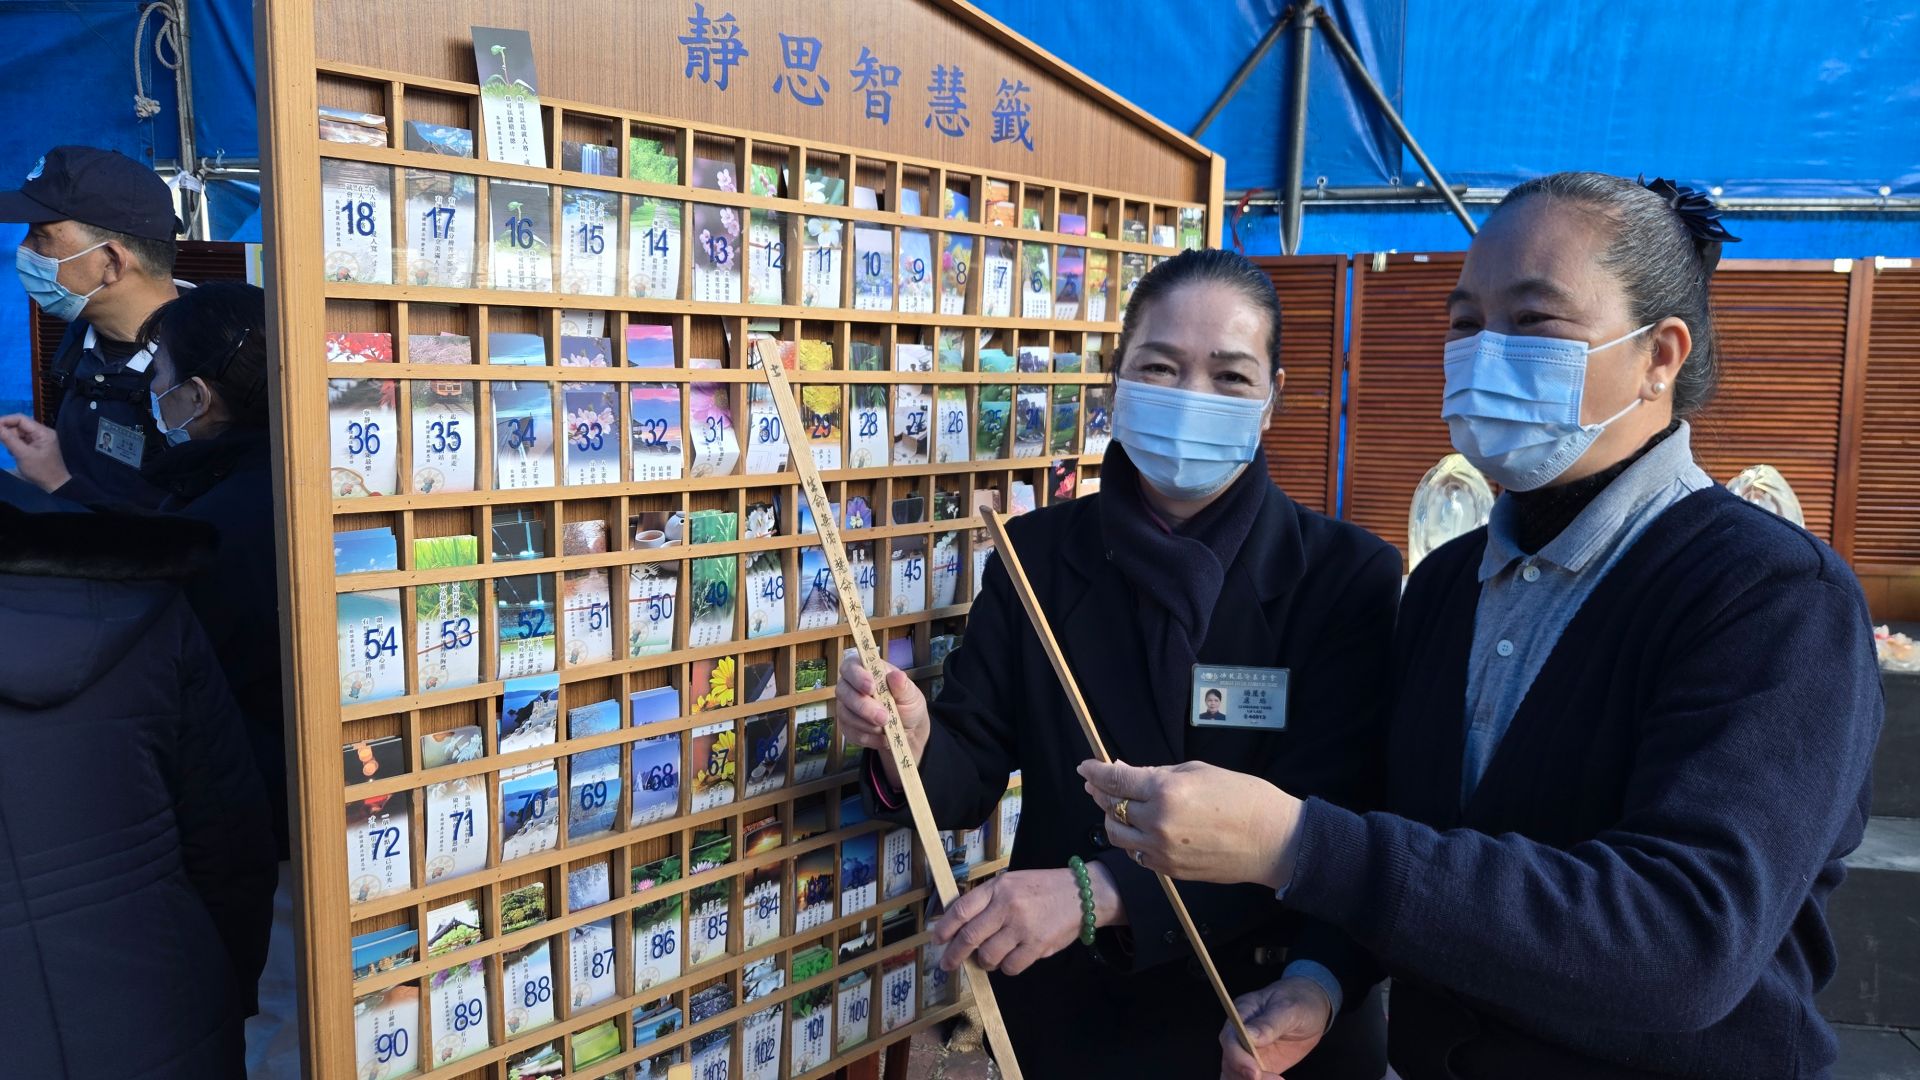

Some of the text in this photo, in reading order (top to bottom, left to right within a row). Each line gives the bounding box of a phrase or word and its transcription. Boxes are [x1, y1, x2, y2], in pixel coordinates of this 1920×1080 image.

[677, 2, 1034, 152] 靜思智慧籤
[341, 200, 375, 237] 18
[426, 206, 456, 239] 17
[505, 216, 534, 250] 16
[578, 223, 605, 255] 15
[643, 228, 669, 257] 14
[706, 236, 729, 264] 13
[764, 241, 785, 270] 12
[816, 246, 831, 273] 11
[862, 250, 881, 277] 10
[913, 258, 925, 283] 9
[956, 261, 967, 285] 8
[997, 266, 1008, 289] 7
[1031, 270, 1043, 293] 6
[507, 418, 536, 450] 34
[644, 418, 668, 446] 32
[705, 416, 724, 443] 31
[759, 416, 780, 442] 30
[811, 414, 832, 439] 29
[860, 412, 878, 436] 28
[907, 412, 925, 435] 27
[948, 410, 963, 433] 26
[987, 409, 1002, 432] 25
[348, 422, 380, 454] 36
[430, 421, 462, 453] 35
[576, 422, 603, 451] 33
[813, 567, 831, 593] 47
[860, 566, 877, 589] 46
[904, 558, 922, 582] 45
[705, 580, 728, 607] 49
[763, 575, 785, 601] 48
[590, 601, 609, 630] 51
[649, 593, 673, 621] 50
[442, 618, 473, 650] 53
[518, 608, 546, 640] 52
[365, 626, 398, 660] 54
[650, 762, 674, 791] 68
[708, 749, 729, 776] 67
[518, 792, 545, 821] 70
[580, 780, 608, 811] 69
[449, 808, 473, 841] 71
[369, 826, 401, 861] 72
[896, 849, 911, 874] 81
[759, 892, 779, 919] 84
[707, 911, 729, 940] 85
[652, 929, 676, 960] 86
[591, 947, 616, 979] 87
[524, 975, 551, 1008] 88
[891, 979, 910, 1005] 99
[454, 998, 483, 1031] 89
[850, 997, 869, 1023] 100
[807, 1015, 825, 1043] 101
[377, 1028, 408, 1063] 90
[755, 1038, 775, 1065] 102
[706, 1059, 728, 1080] 103
